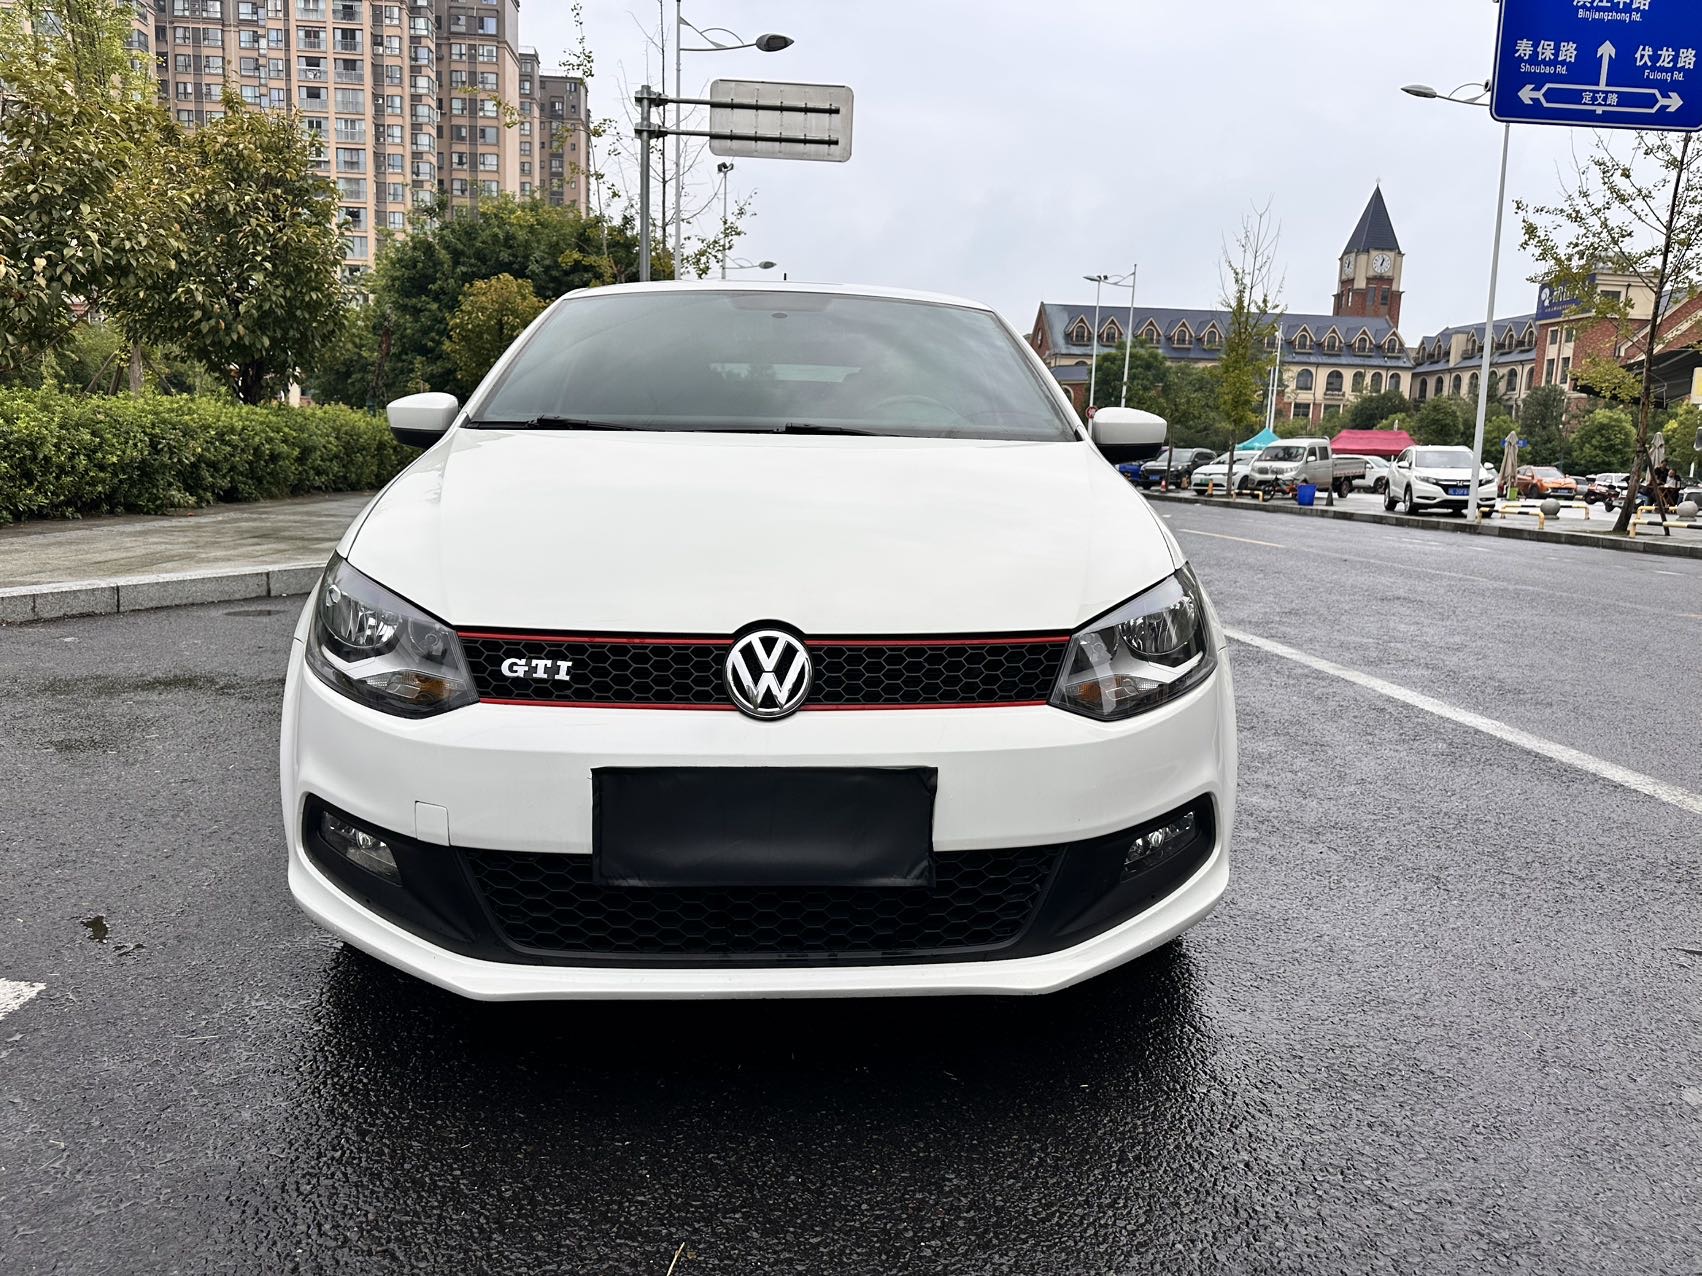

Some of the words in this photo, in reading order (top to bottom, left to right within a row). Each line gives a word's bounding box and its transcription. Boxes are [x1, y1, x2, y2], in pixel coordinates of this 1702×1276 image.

[1577, 8, 1630, 24] Binjiangzhong
[1631, 11, 1643, 22] Rd.
[1514, 38, 1578, 63] 寿保路
[1634, 45, 1697, 69] 伏龙路
[1520, 62, 1555, 74] Shoubao
[1556, 64, 1568, 75] Rd.
[1644, 69, 1672, 83] Fulong
[1673, 71, 1685, 81] Rd.
[1581, 91, 1619, 106] 定文路
[500, 657, 573, 681] GTI
